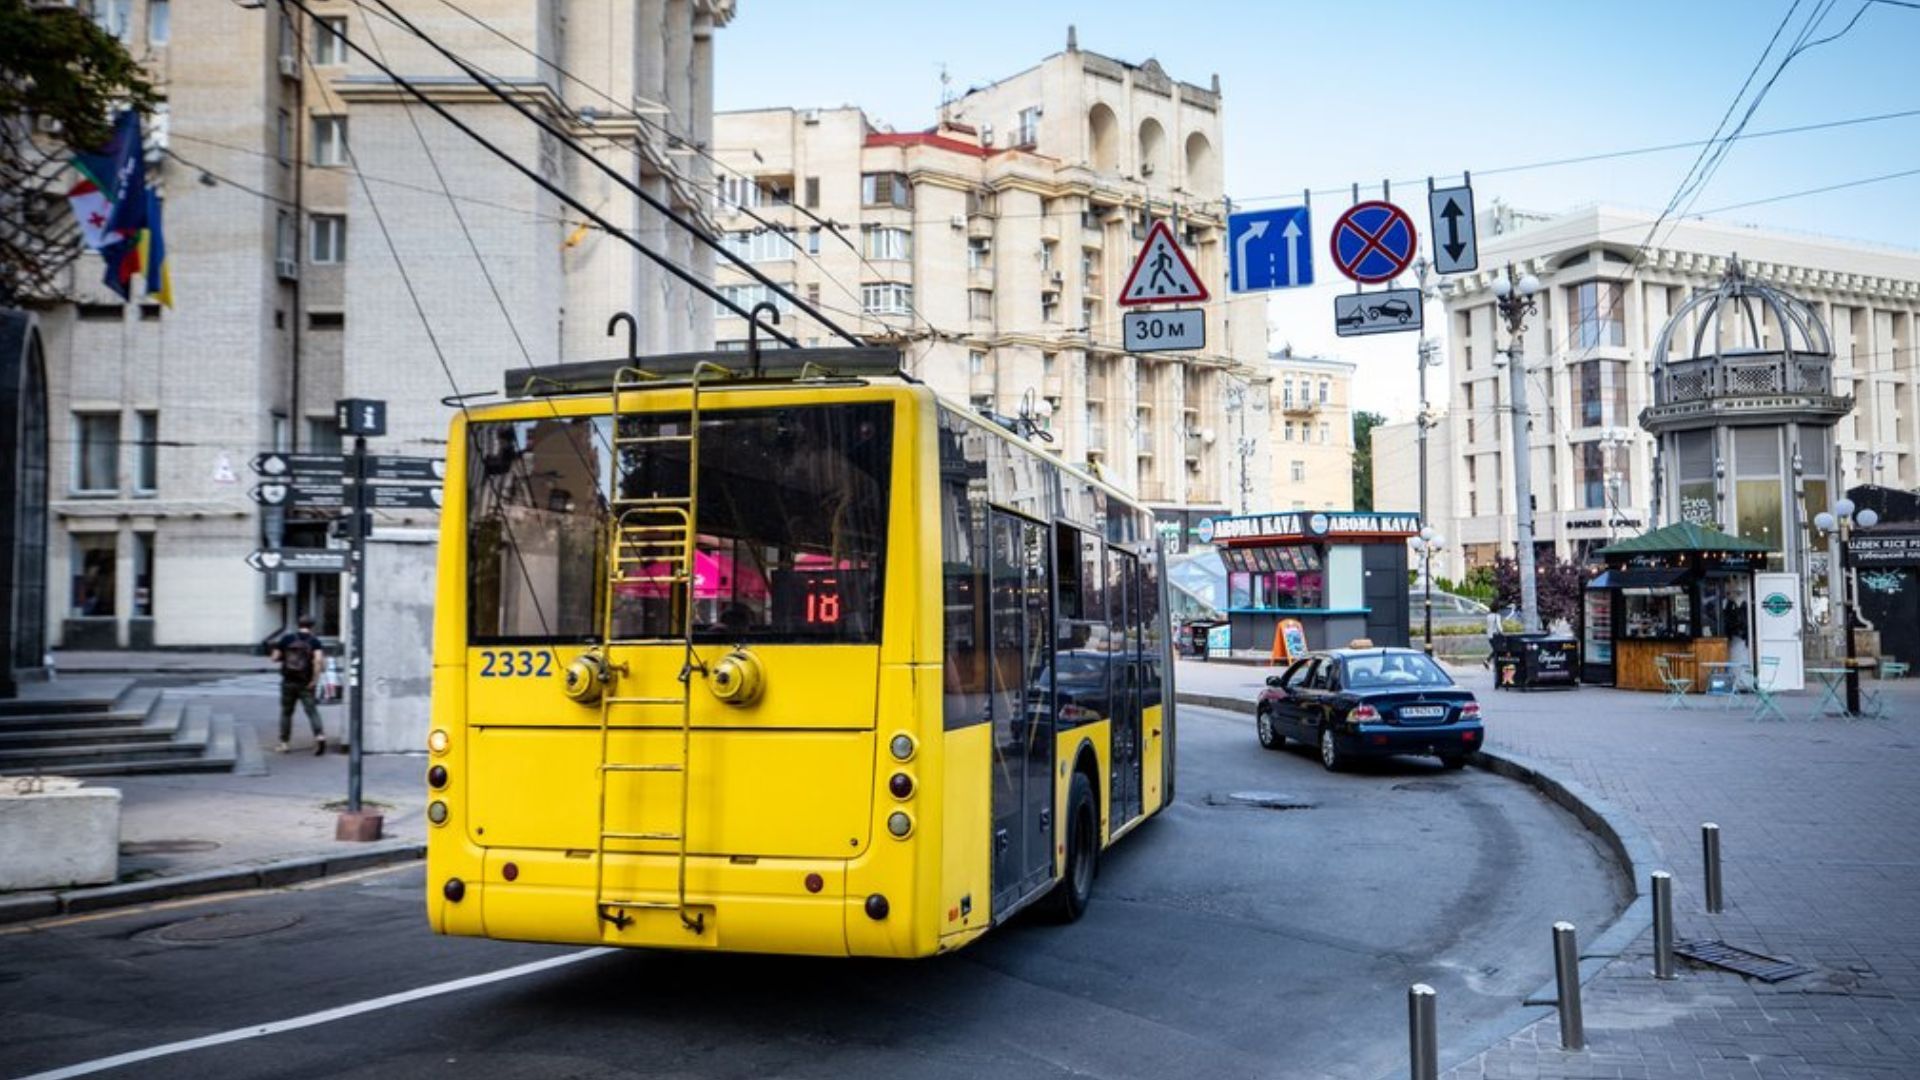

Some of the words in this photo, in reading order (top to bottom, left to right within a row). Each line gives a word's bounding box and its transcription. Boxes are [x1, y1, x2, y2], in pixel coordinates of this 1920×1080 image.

[1136, 319, 1164, 340] 30
[1329, 517, 1378, 531] AROMA
[1382, 517, 1418, 531] KAVA
[1849, 540, 1880, 549] UZBEK
[1883, 540, 1906, 549] RICE
[480, 651, 552, 677] 2332
